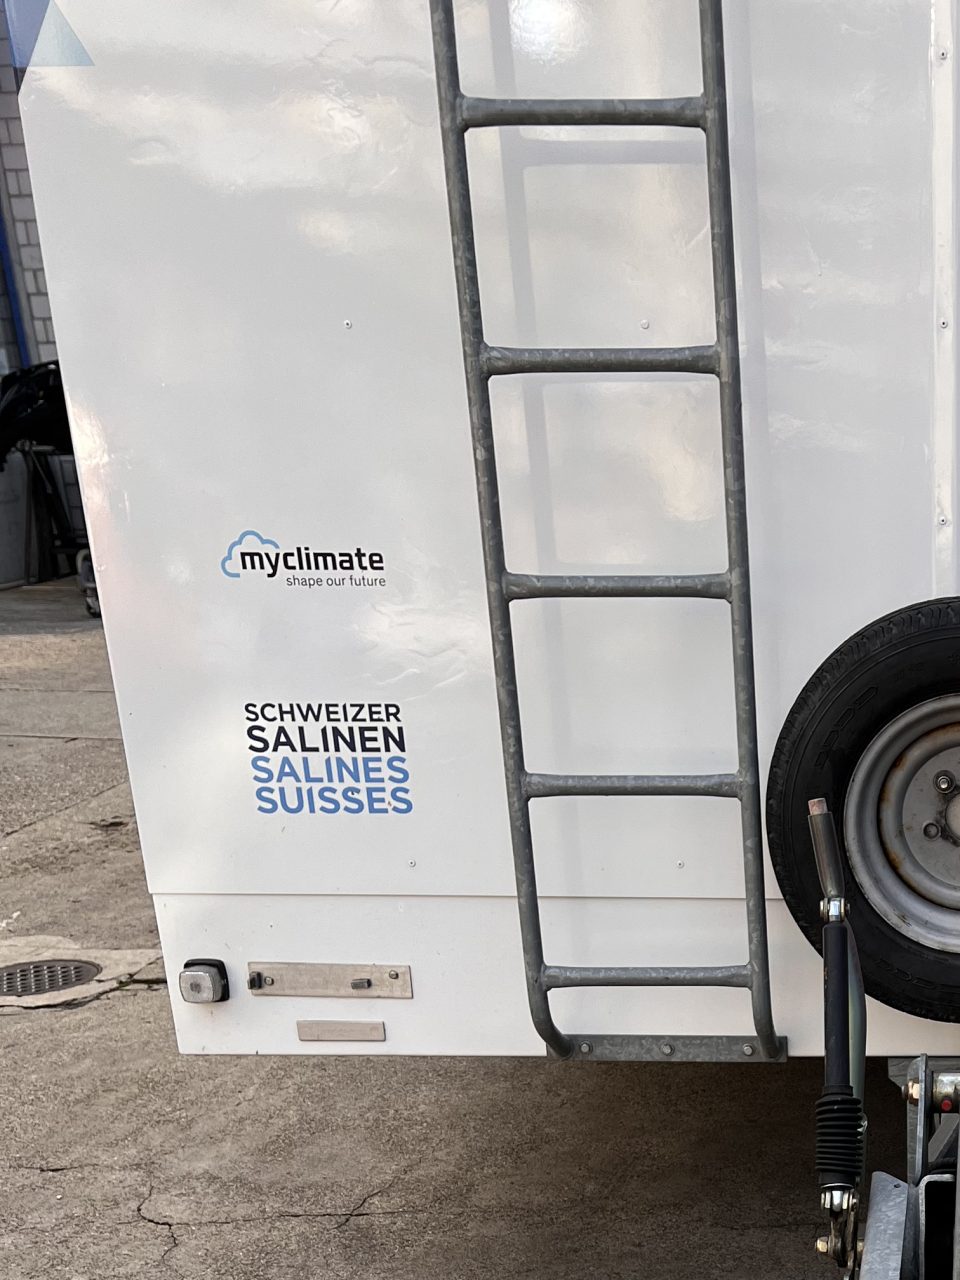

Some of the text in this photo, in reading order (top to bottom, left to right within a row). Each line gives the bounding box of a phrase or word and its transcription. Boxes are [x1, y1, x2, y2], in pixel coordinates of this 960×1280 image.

[240, 547, 385, 578] myclimate
[286, 575, 386, 588] shape our future
[244, 702, 401, 722] SCHWEIZER
[247, 725, 406, 753] SALINEN
[251, 755, 410, 784] SALINES
[255, 786, 414, 814] SUISSES
